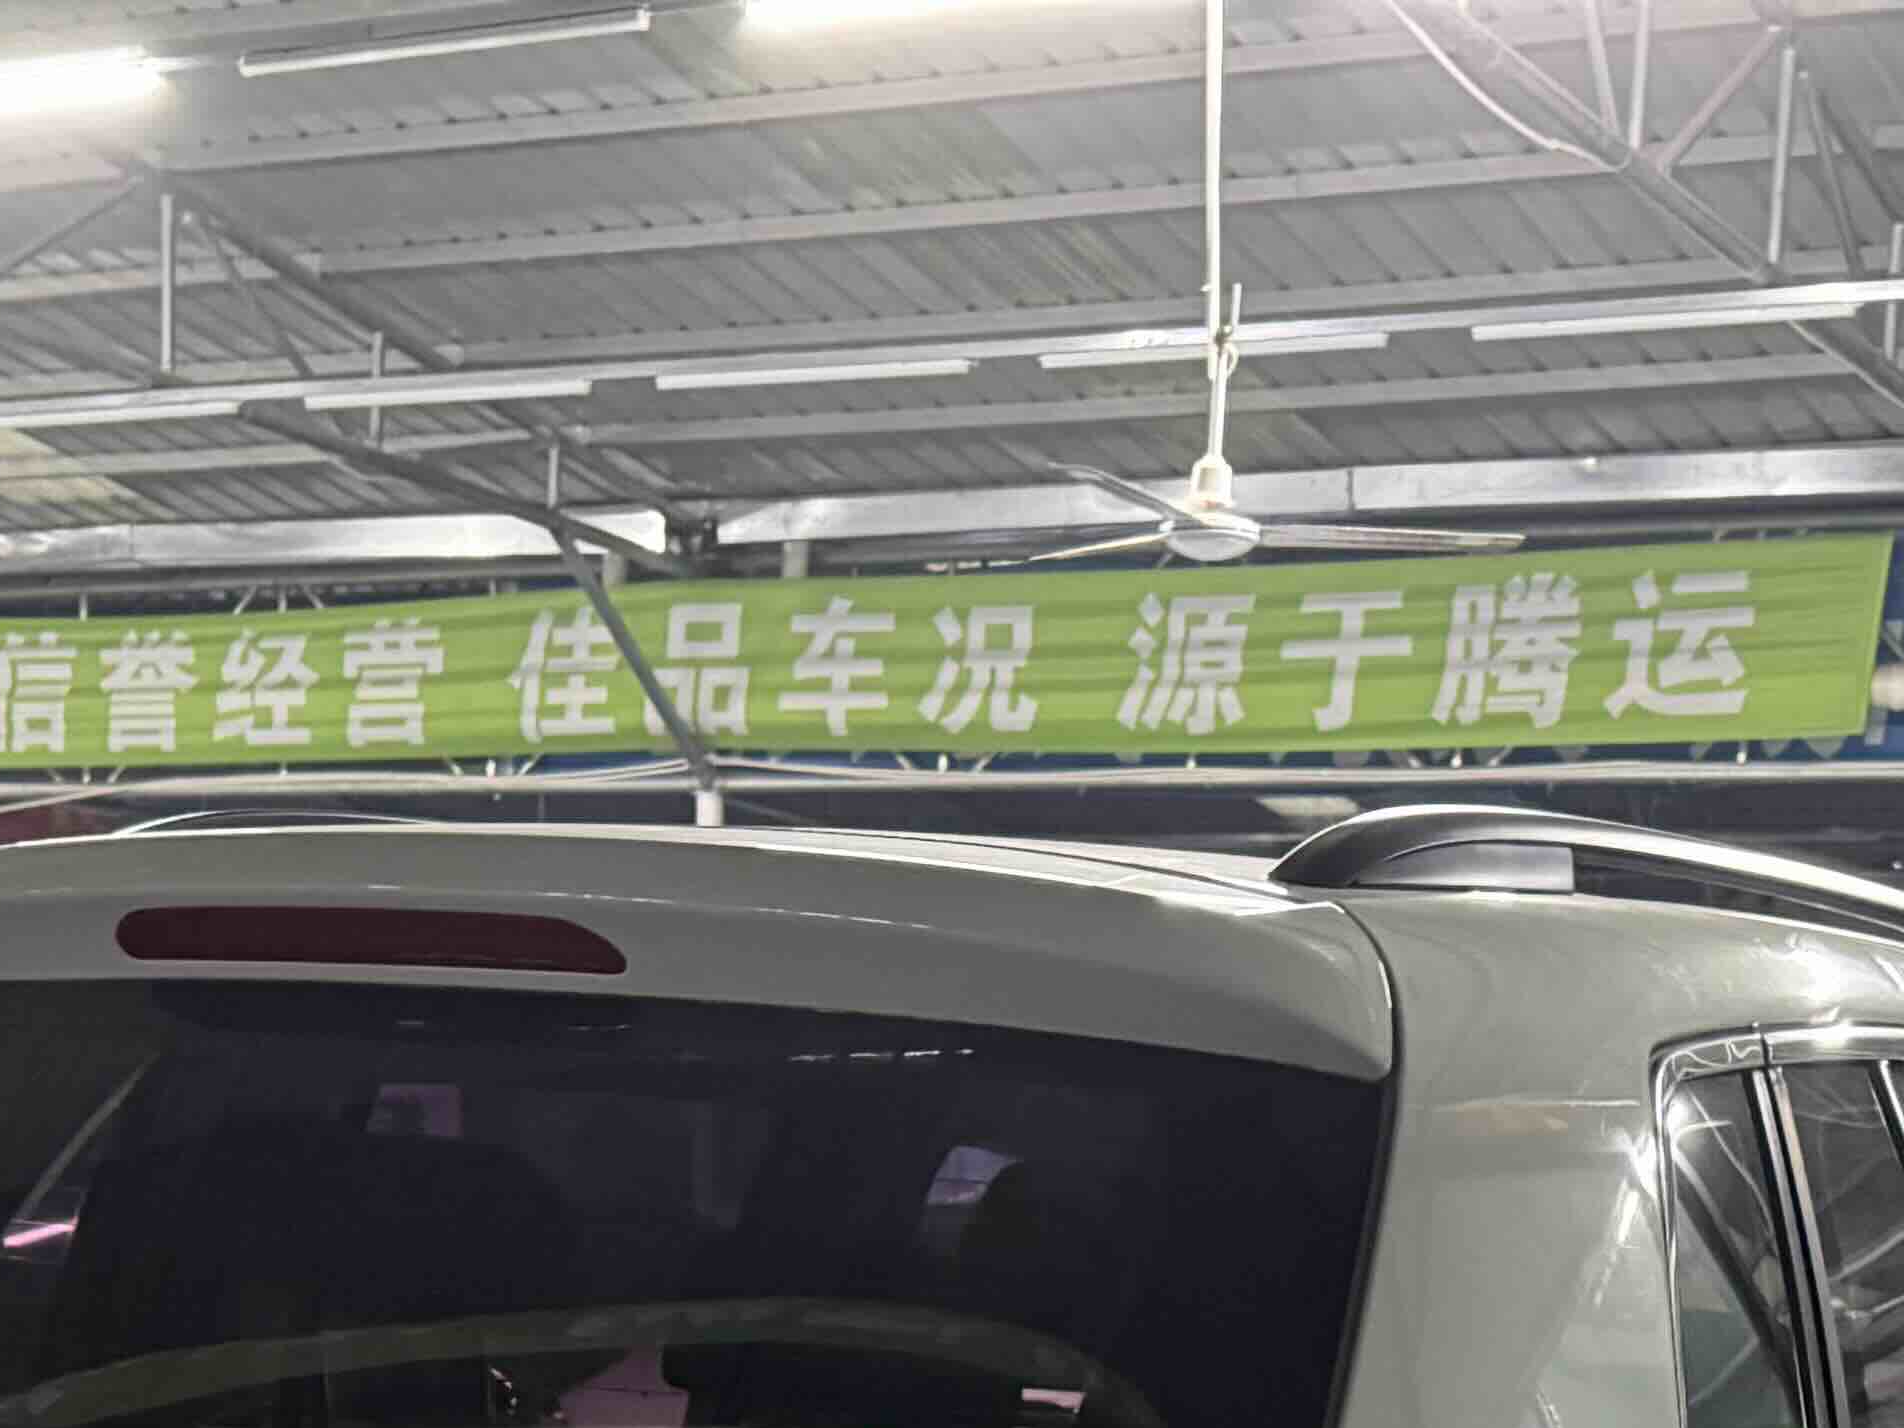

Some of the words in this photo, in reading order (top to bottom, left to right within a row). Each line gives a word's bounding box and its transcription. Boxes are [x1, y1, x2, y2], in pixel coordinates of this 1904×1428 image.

[508, 594, 1037, 742] 佳品车况
[1117, 570, 1755, 735] 源于腾运
